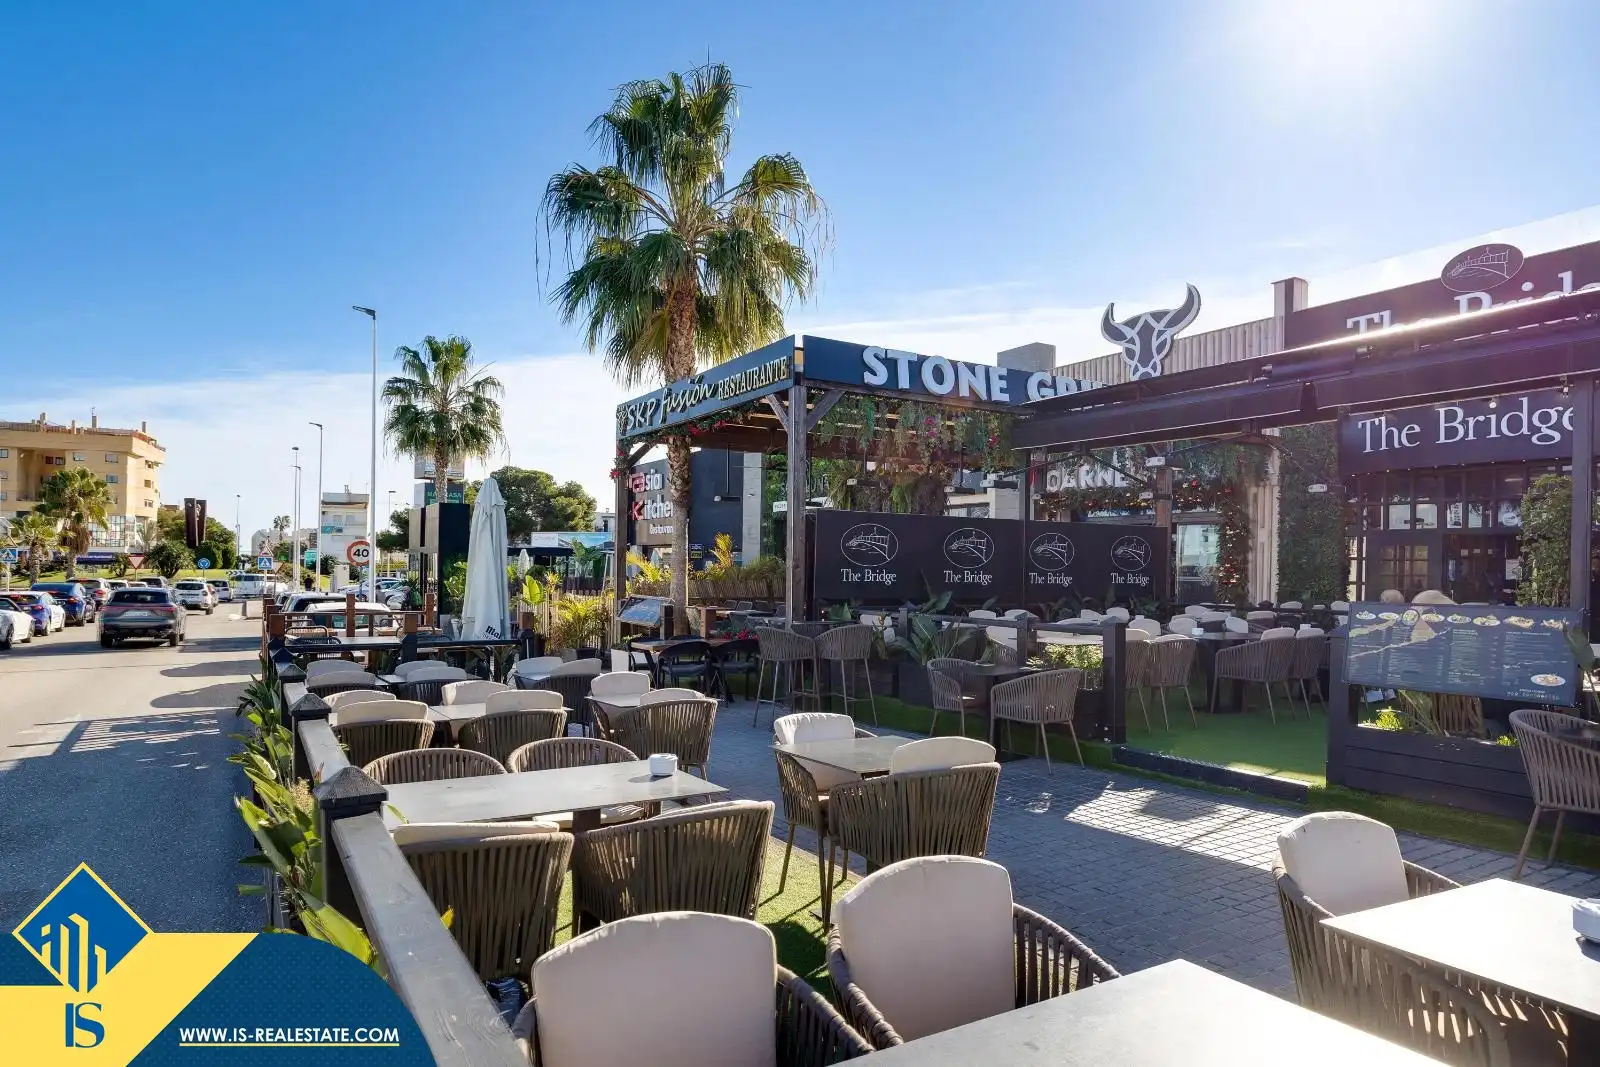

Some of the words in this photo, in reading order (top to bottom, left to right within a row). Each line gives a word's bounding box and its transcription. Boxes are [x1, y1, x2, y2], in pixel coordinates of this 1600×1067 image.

[862, 345, 1010, 401] STONE
[627, 398, 656, 430] SKP
[718, 356, 788, 400] RESTAURANTE
[1357, 415, 1421, 453] The
[353, 548, 370, 558] 40
[841, 568, 861, 582] The
[864, 569, 897, 585] Bridge
[943, 570, 961, 583] The
[963, 571, 993, 585] Bridge
[1029, 572, 1045, 584] The
[1047, 573, 1073, 587] Bridge
[1110, 572, 1125, 584] The
[1126, 573, 1150, 587] Bridge
